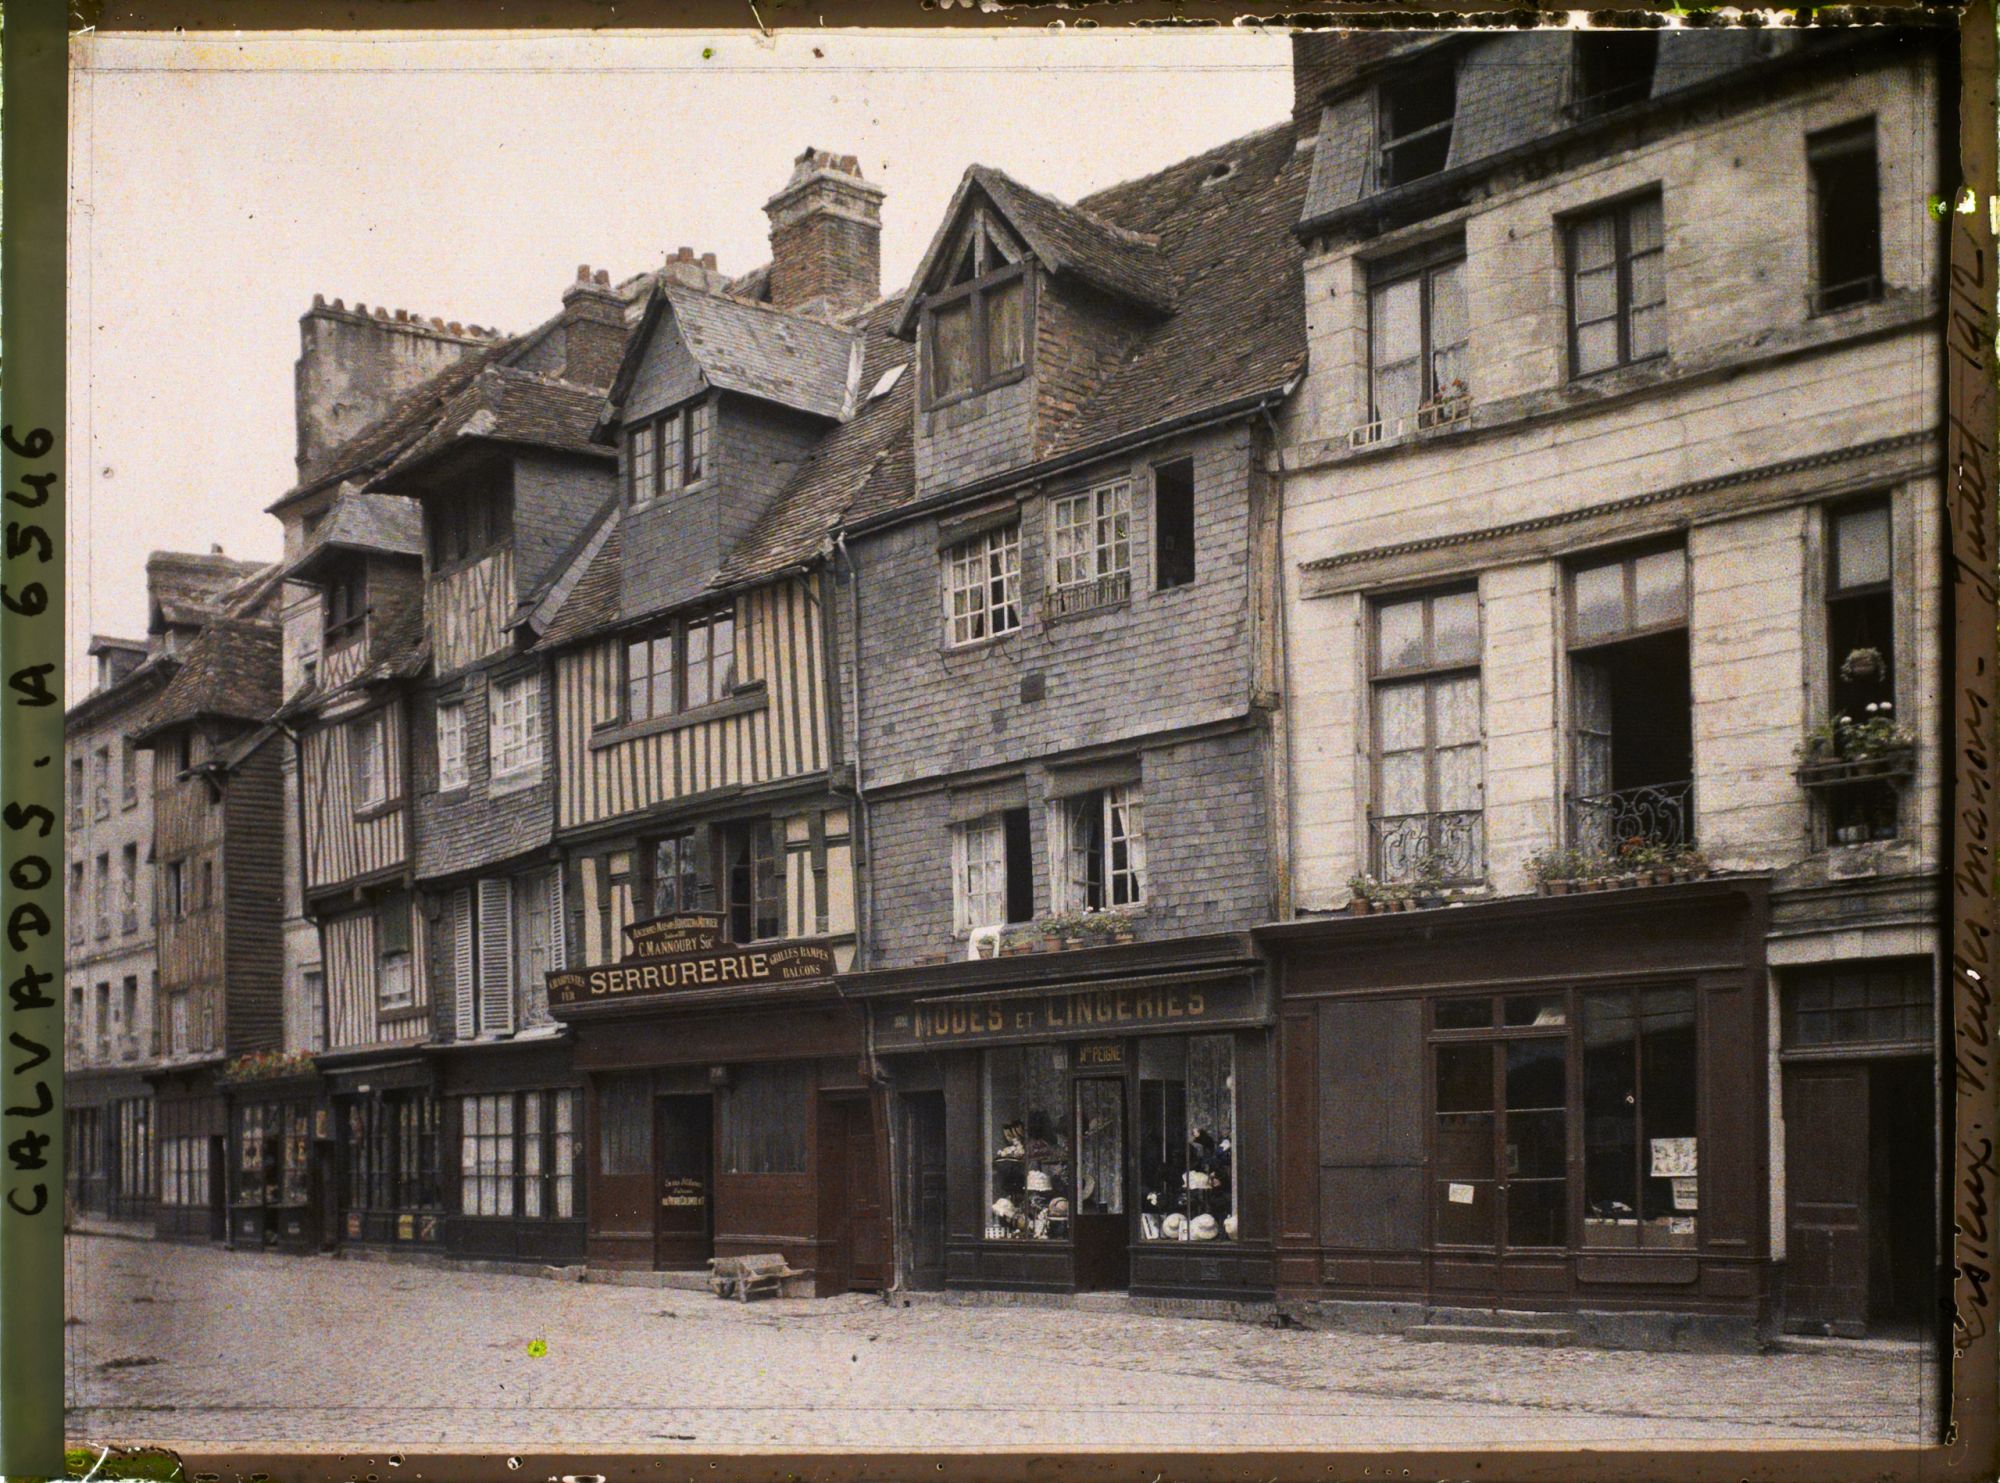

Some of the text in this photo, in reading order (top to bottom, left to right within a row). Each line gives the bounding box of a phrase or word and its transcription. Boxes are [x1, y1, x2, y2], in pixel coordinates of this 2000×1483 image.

[769, 946, 829, 966] GRILLES RAMPES
[590, 954, 770, 995] SERRURERIE
[783, 964, 821, 979] BALCONS
[915, 990, 1205, 1039] MODES ET LINGERIES
